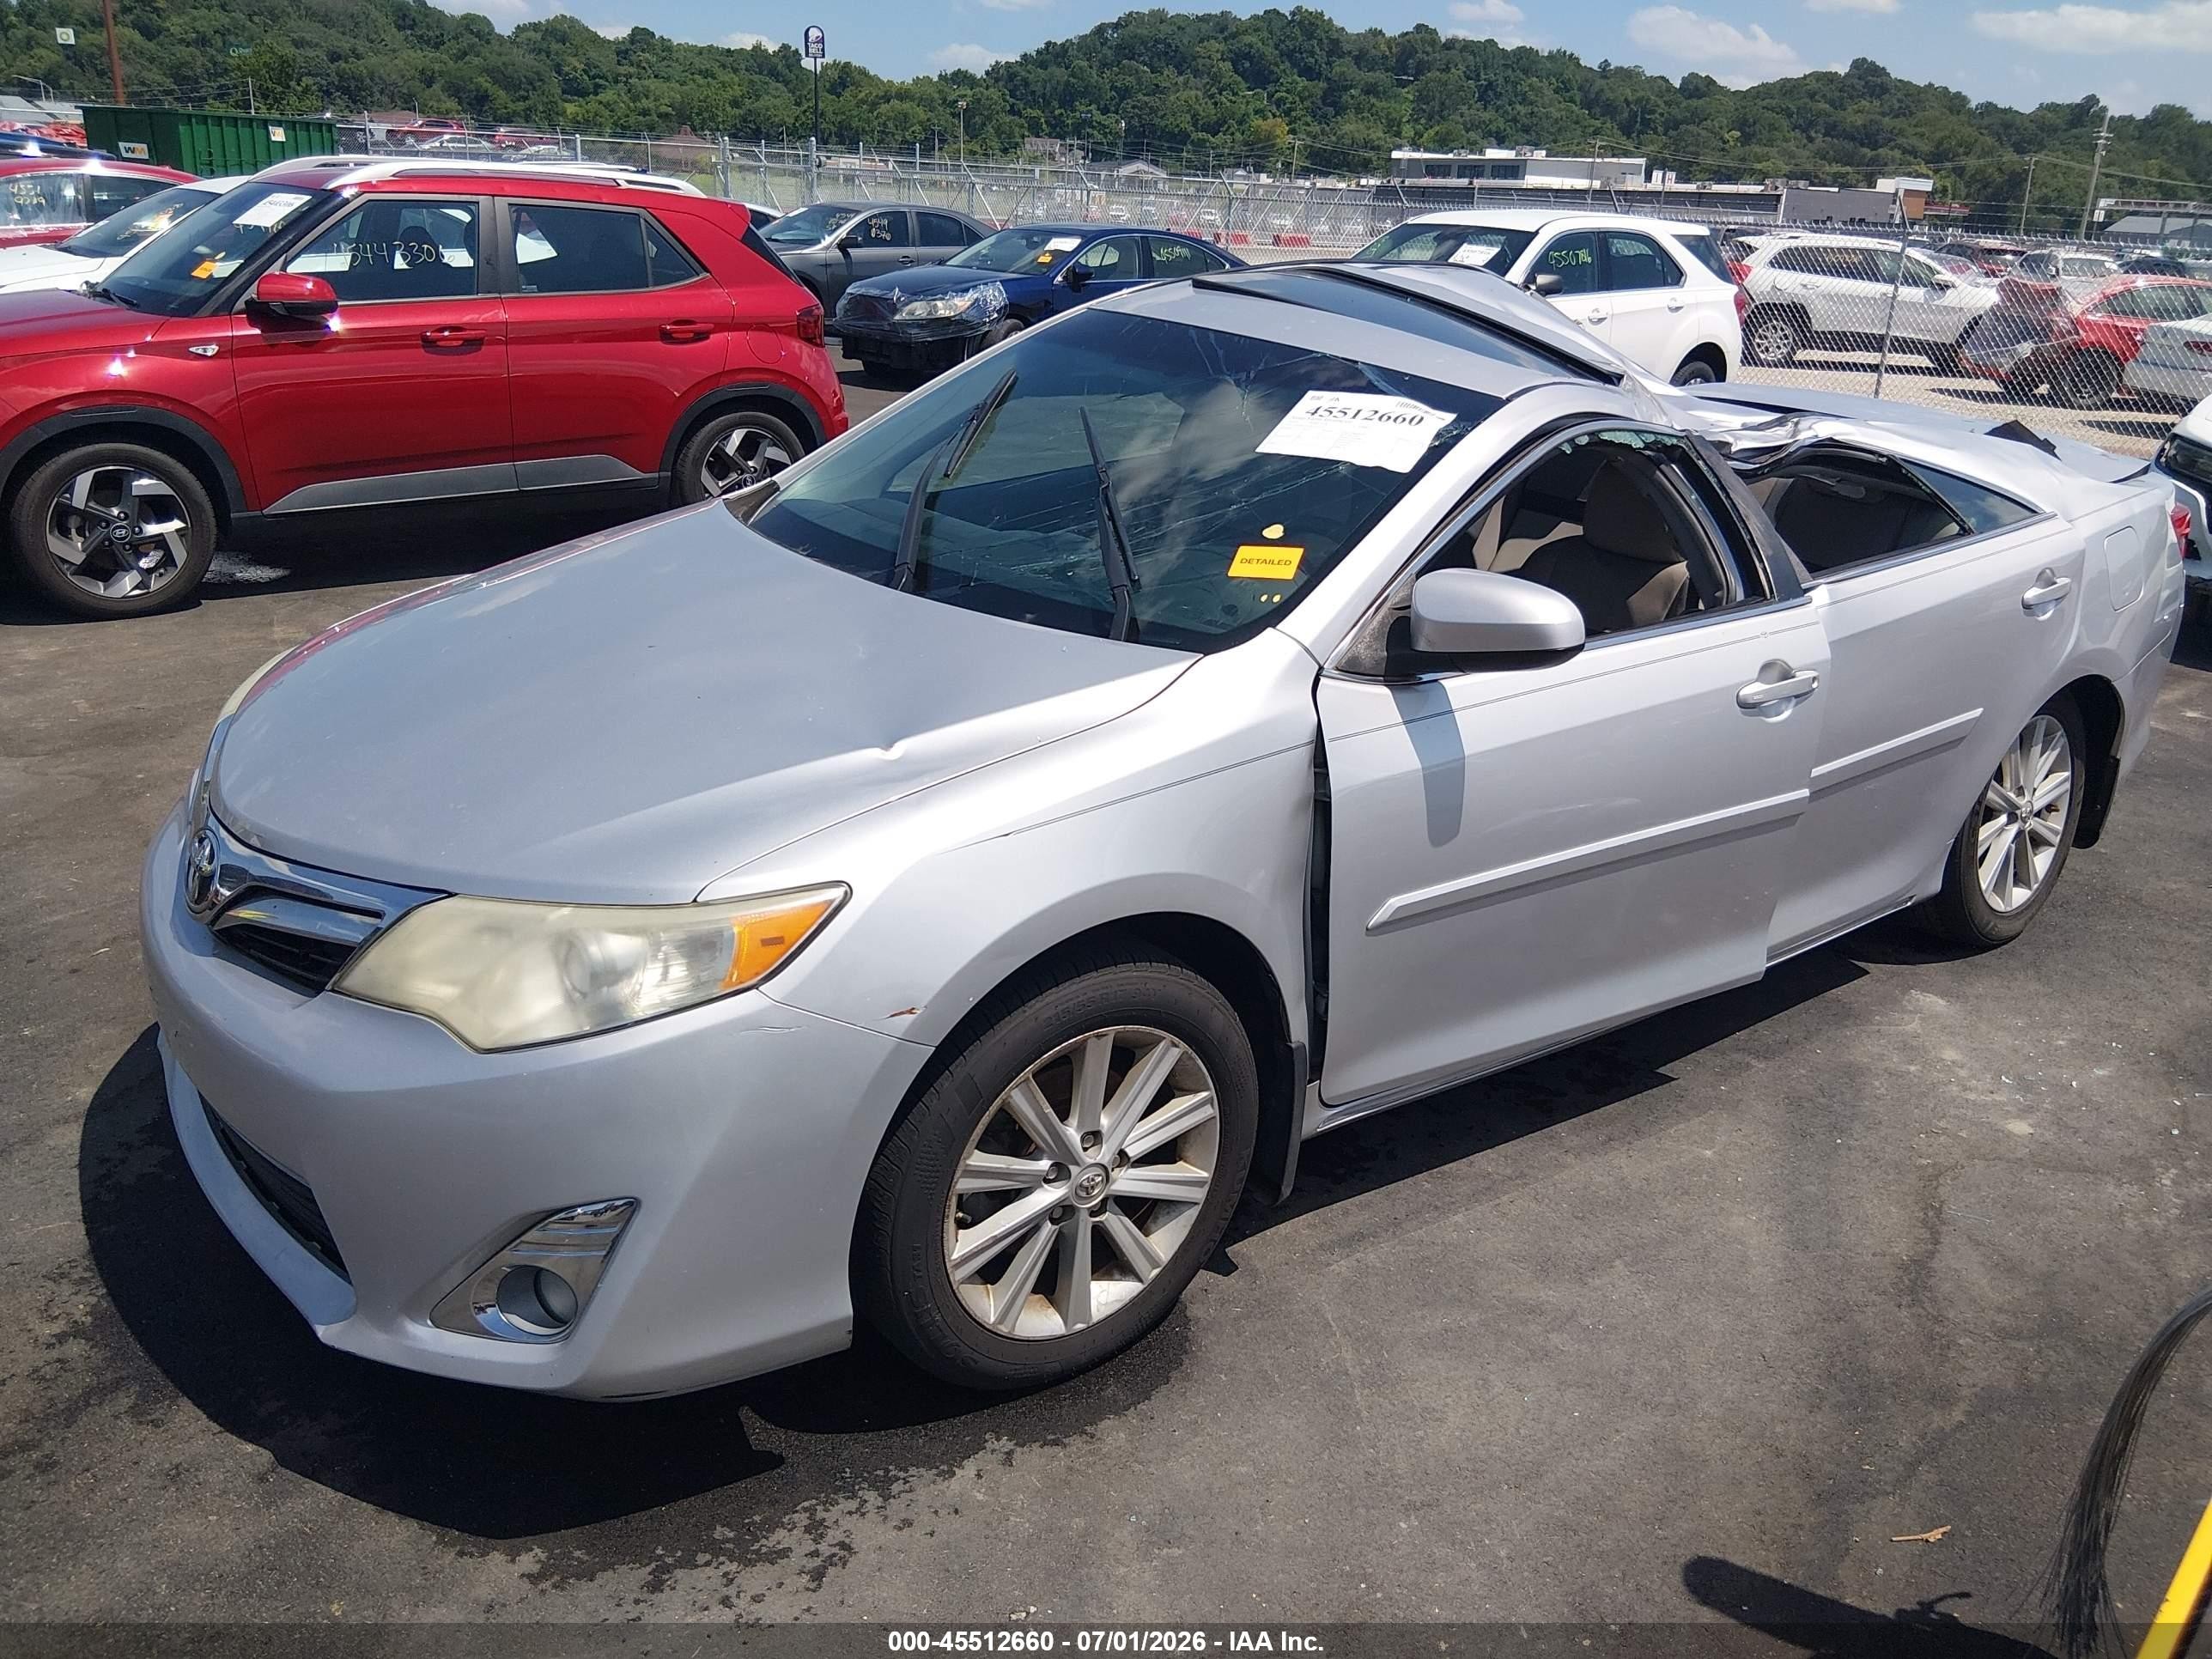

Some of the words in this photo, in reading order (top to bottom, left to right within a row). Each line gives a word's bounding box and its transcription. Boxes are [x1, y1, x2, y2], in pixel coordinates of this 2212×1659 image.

[124, 146, 147, 155] WM
[1304, 405, 1425, 427] 45512660
[1239, 557, 1293, 567] DETAILED
